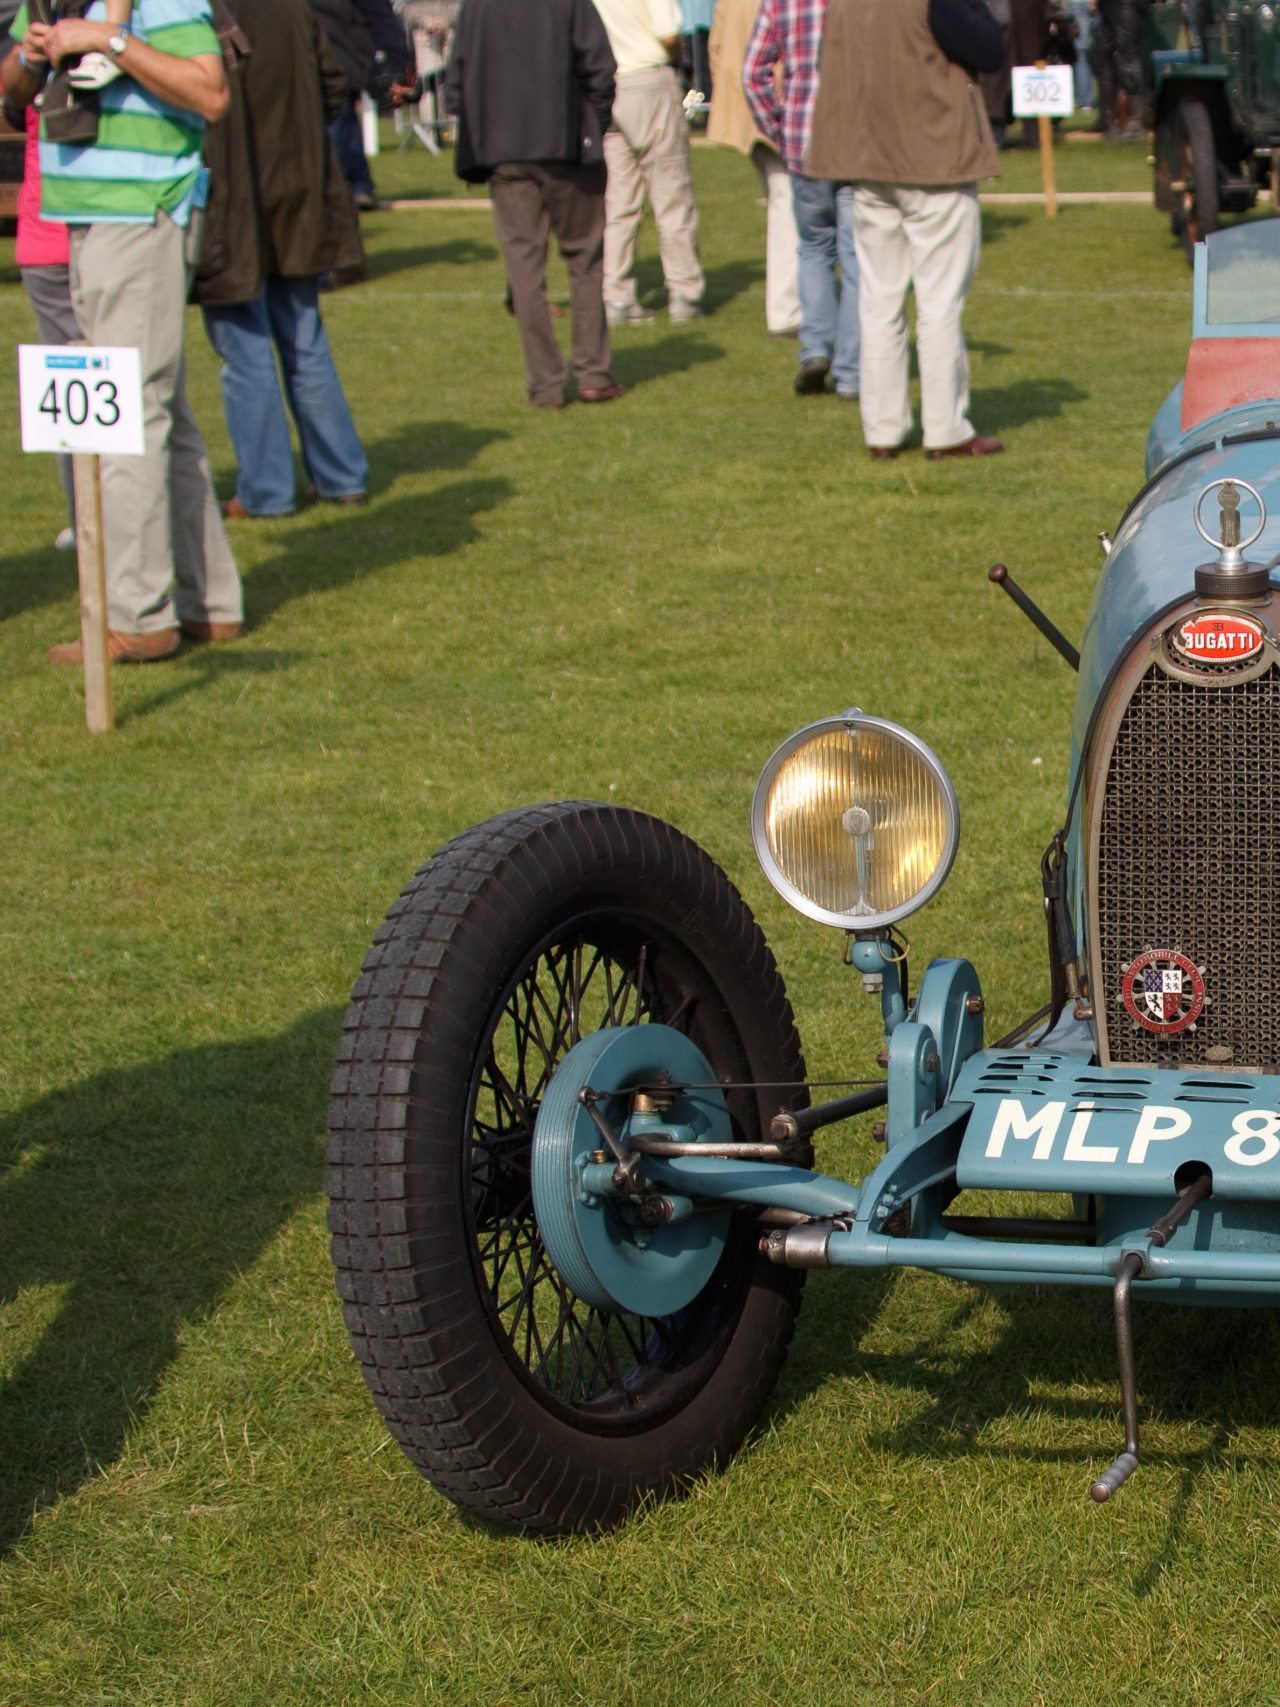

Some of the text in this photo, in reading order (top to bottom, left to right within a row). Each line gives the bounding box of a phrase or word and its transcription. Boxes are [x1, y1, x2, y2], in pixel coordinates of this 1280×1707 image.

[1022, 82, 1063, 103] 302
[39, 378, 120, 426] 403
[1184, 632, 1254, 649] BUGATTI
[985, 1098, 1192, 1165] MLP
